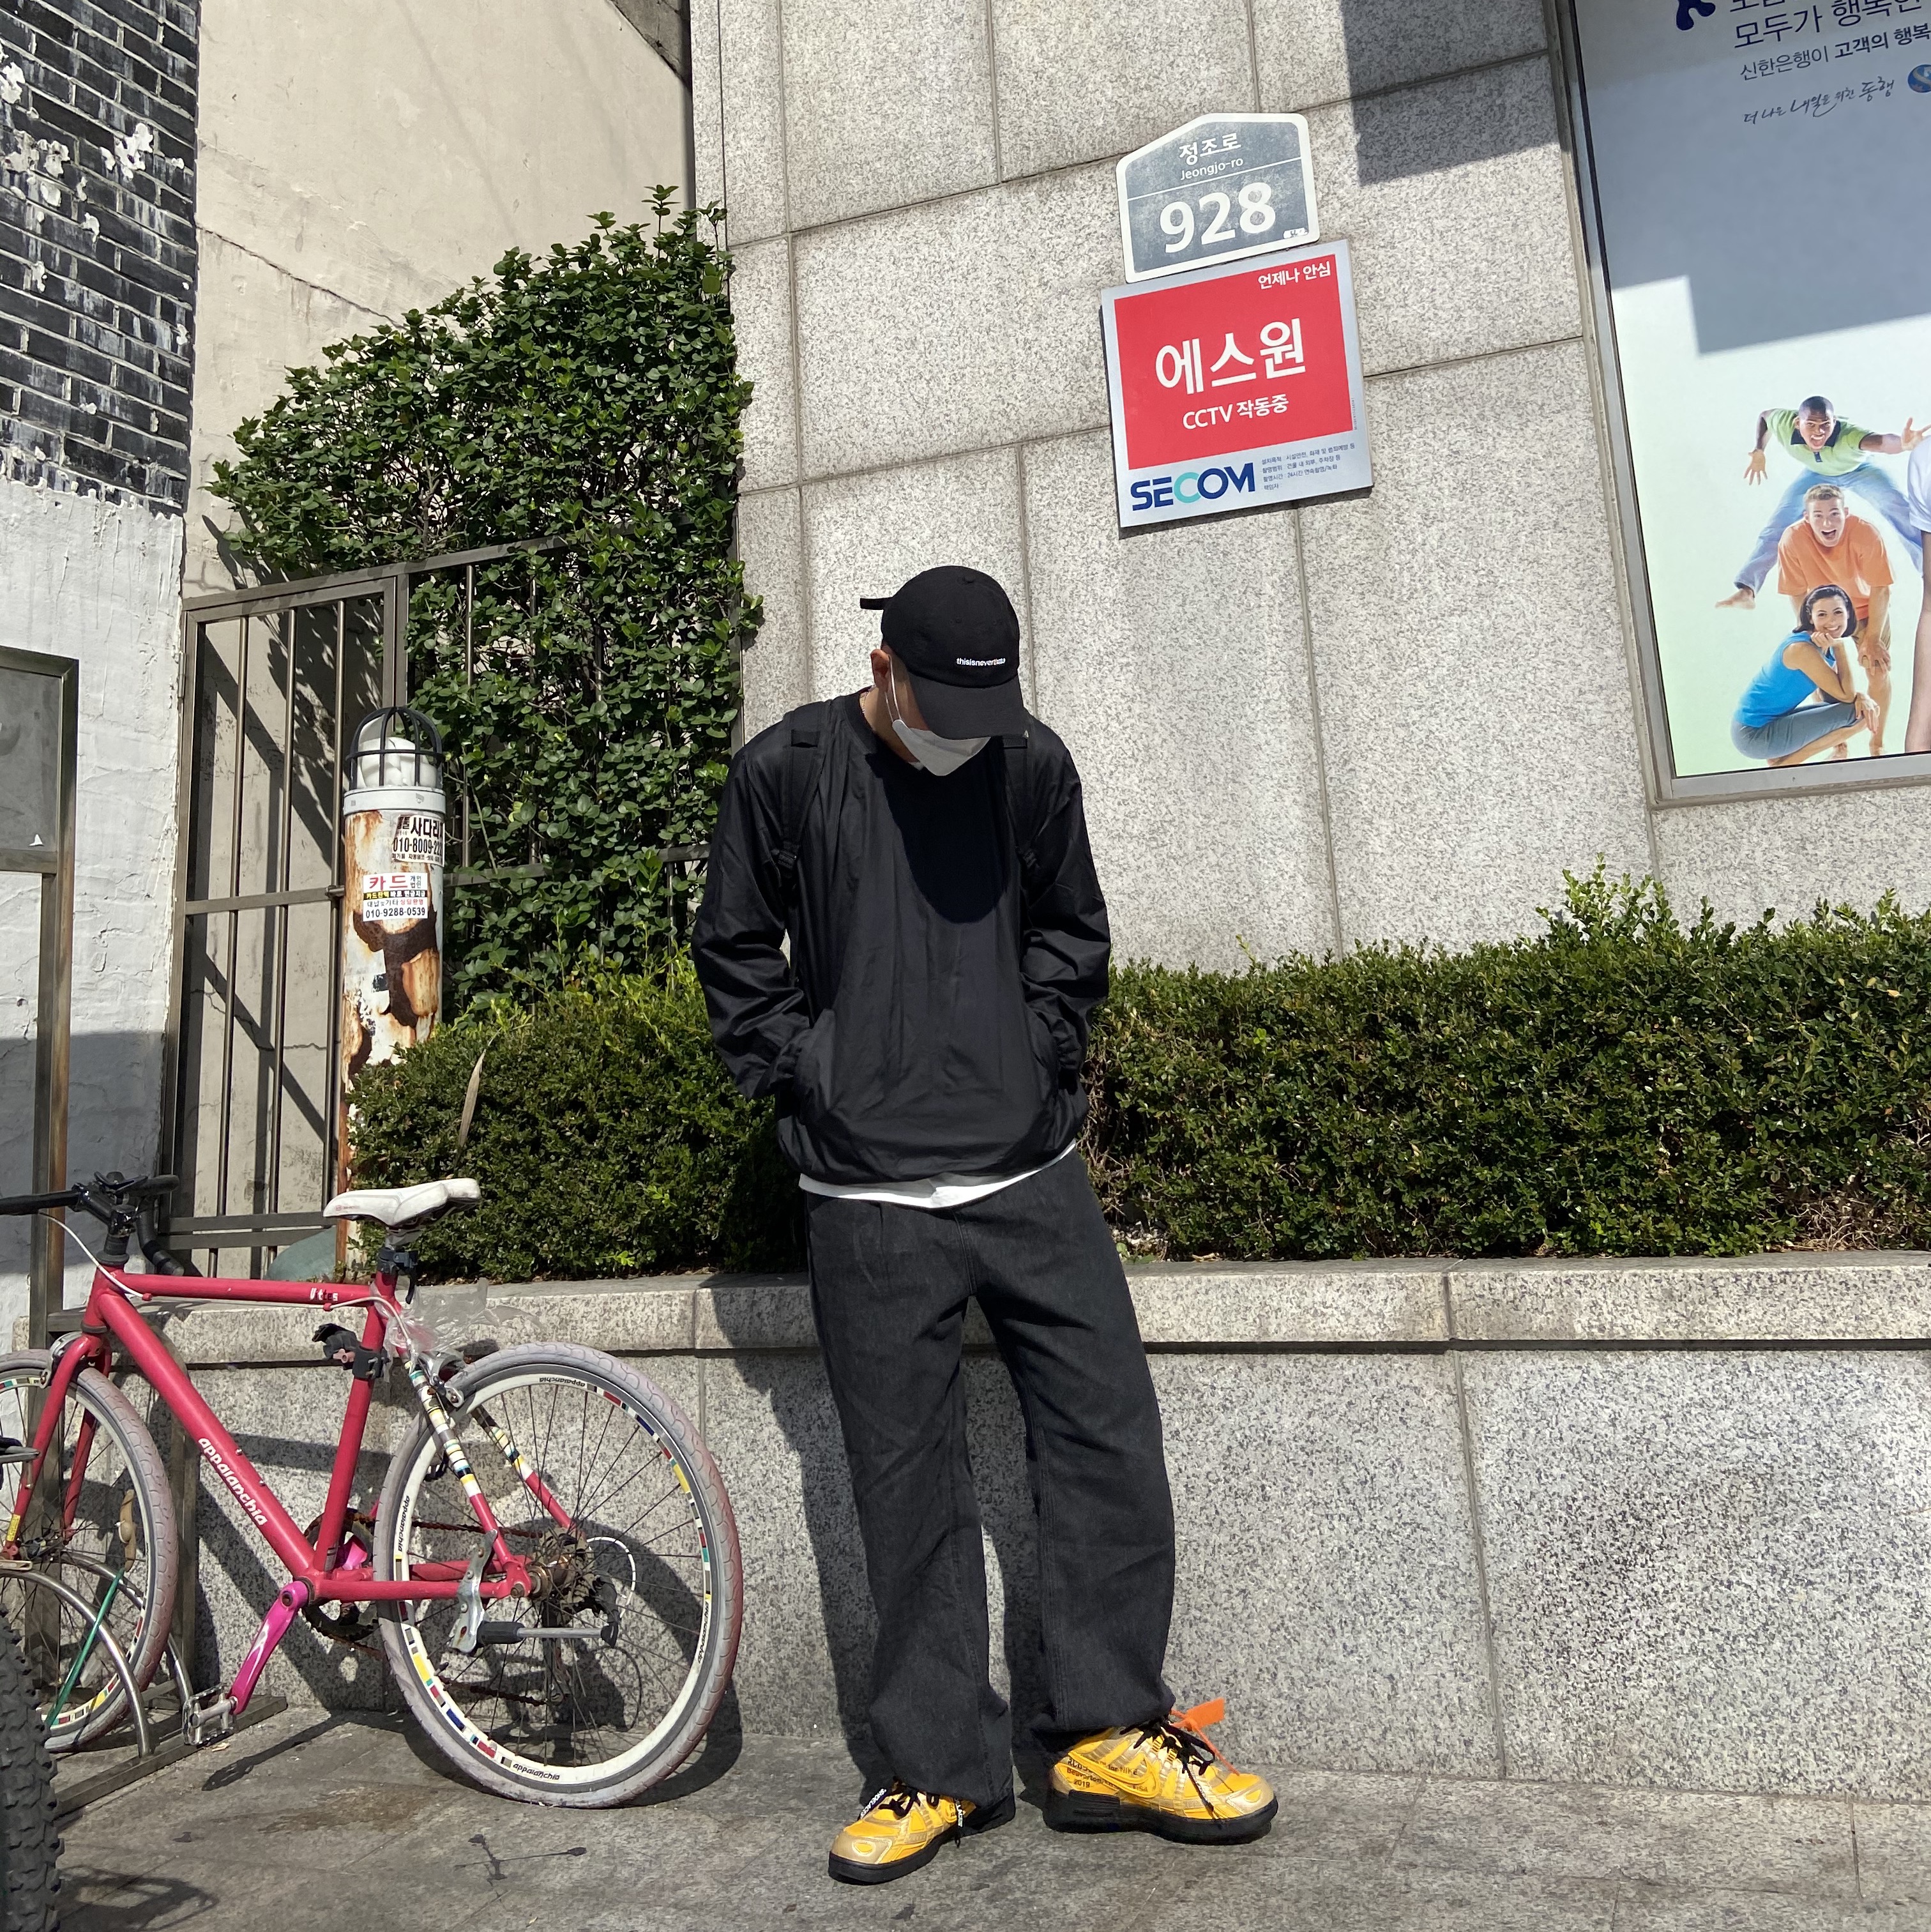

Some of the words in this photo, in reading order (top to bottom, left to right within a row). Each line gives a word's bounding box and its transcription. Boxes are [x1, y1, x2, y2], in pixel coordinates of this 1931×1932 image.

[1734, 5, 1823, 49] 모두가
[1740, 45, 1829, 81] 신한은행이
[1835, 32, 1889, 59] 고객의
[1743, 110, 1758, 125] 더
[1761, 106, 1787, 119] 나은
[1835, 87, 1856, 102] 위한
[1859, 75, 1895, 102] 동행
[1179, 132, 1242, 165] 정조로
[1180, 158, 1244, 181] Jeongjo-ro
[1160, 182, 1276, 254] 928
[1257, 267, 1300, 290] 언제나
[1303, 261, 1331, 280] 안심
[1155, 317, 1306, 395] 에스원
[1183, 404, 1234, 430] CCTV
[1236, 393, 1289, 419] 작동중
[1130, 462, 1255, 512] SECOM
[369, 875, 408, 892] 카드
[365, 907, 426, 918] 010-9288-0539
